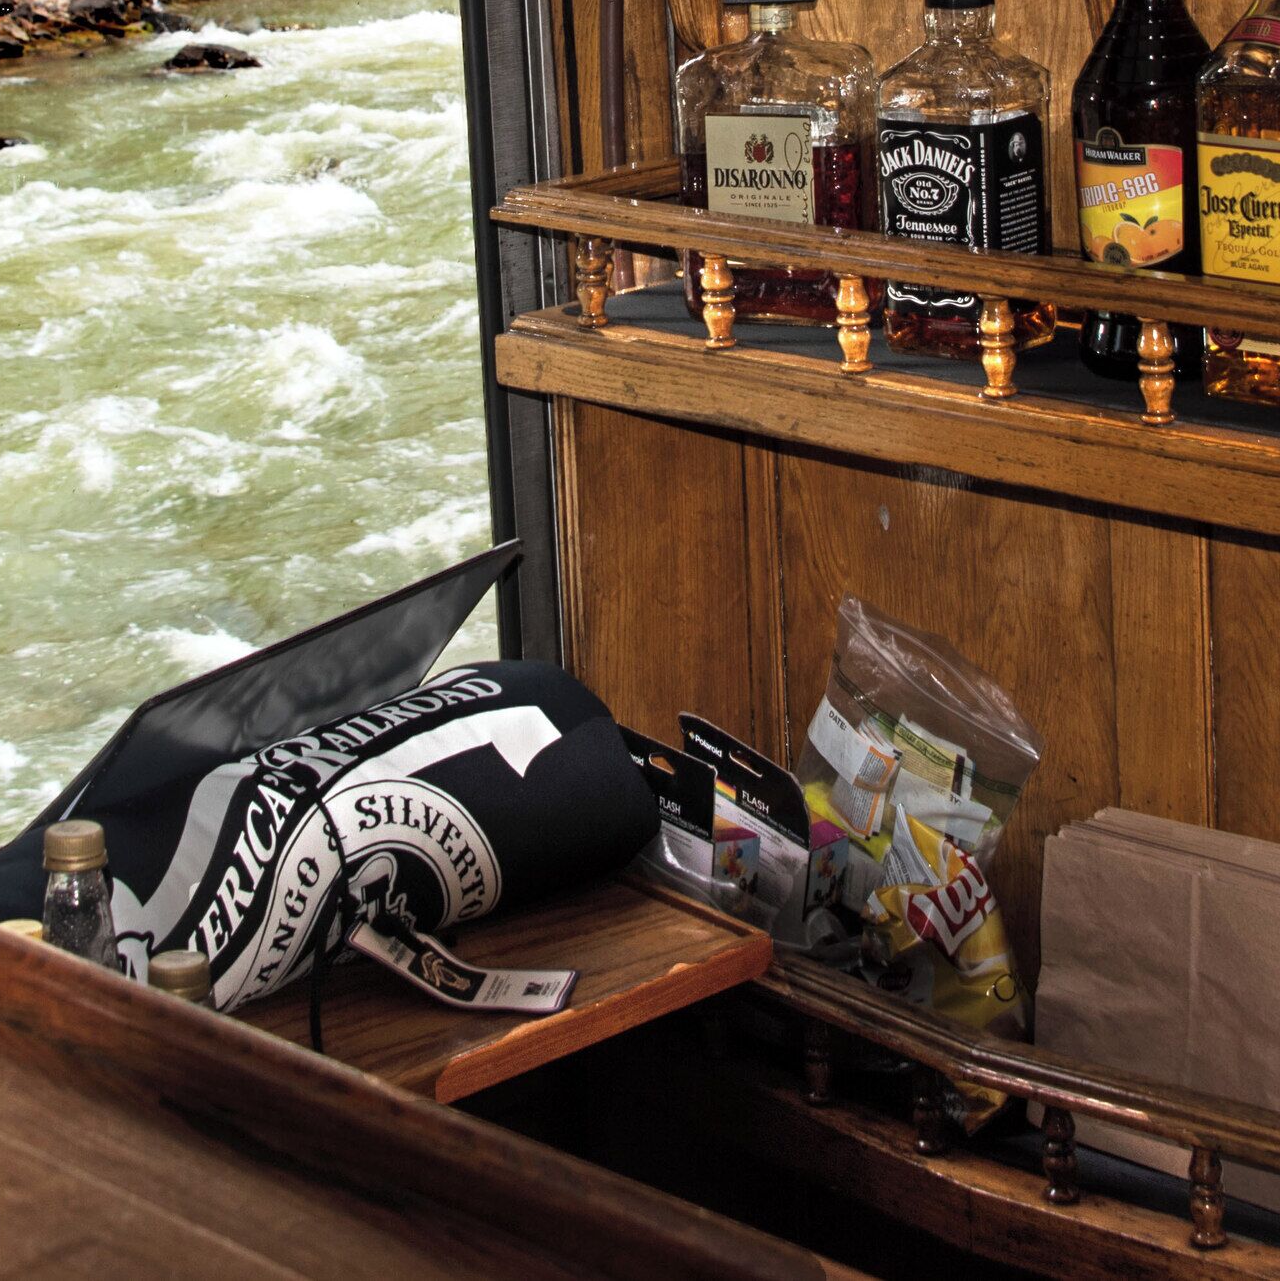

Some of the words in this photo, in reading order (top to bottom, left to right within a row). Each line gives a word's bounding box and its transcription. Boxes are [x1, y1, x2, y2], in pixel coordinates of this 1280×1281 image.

[880, 145, 914, 177] JACK
[913, 139, 976, 184] DANIEL'S
[714, 167, 806, 191] DISARONNO
[1201, 185, 1236, 216] Jose
[896, 214, 958, 235] Tennessee
[1227, 219, 1272, 239] Especial
[1216, 240, 1257, 255] TEQUILA
[1230, 261, 1247, 269] BLUE
[1248, 263, 1270, 272] AGAVE
[828, 710, 848, 731] DATE:
[694, 734, 723, 758] Polaroid
[659, 796, 681, 816] FLASH
[742, 790, 770, 814] FLASH
